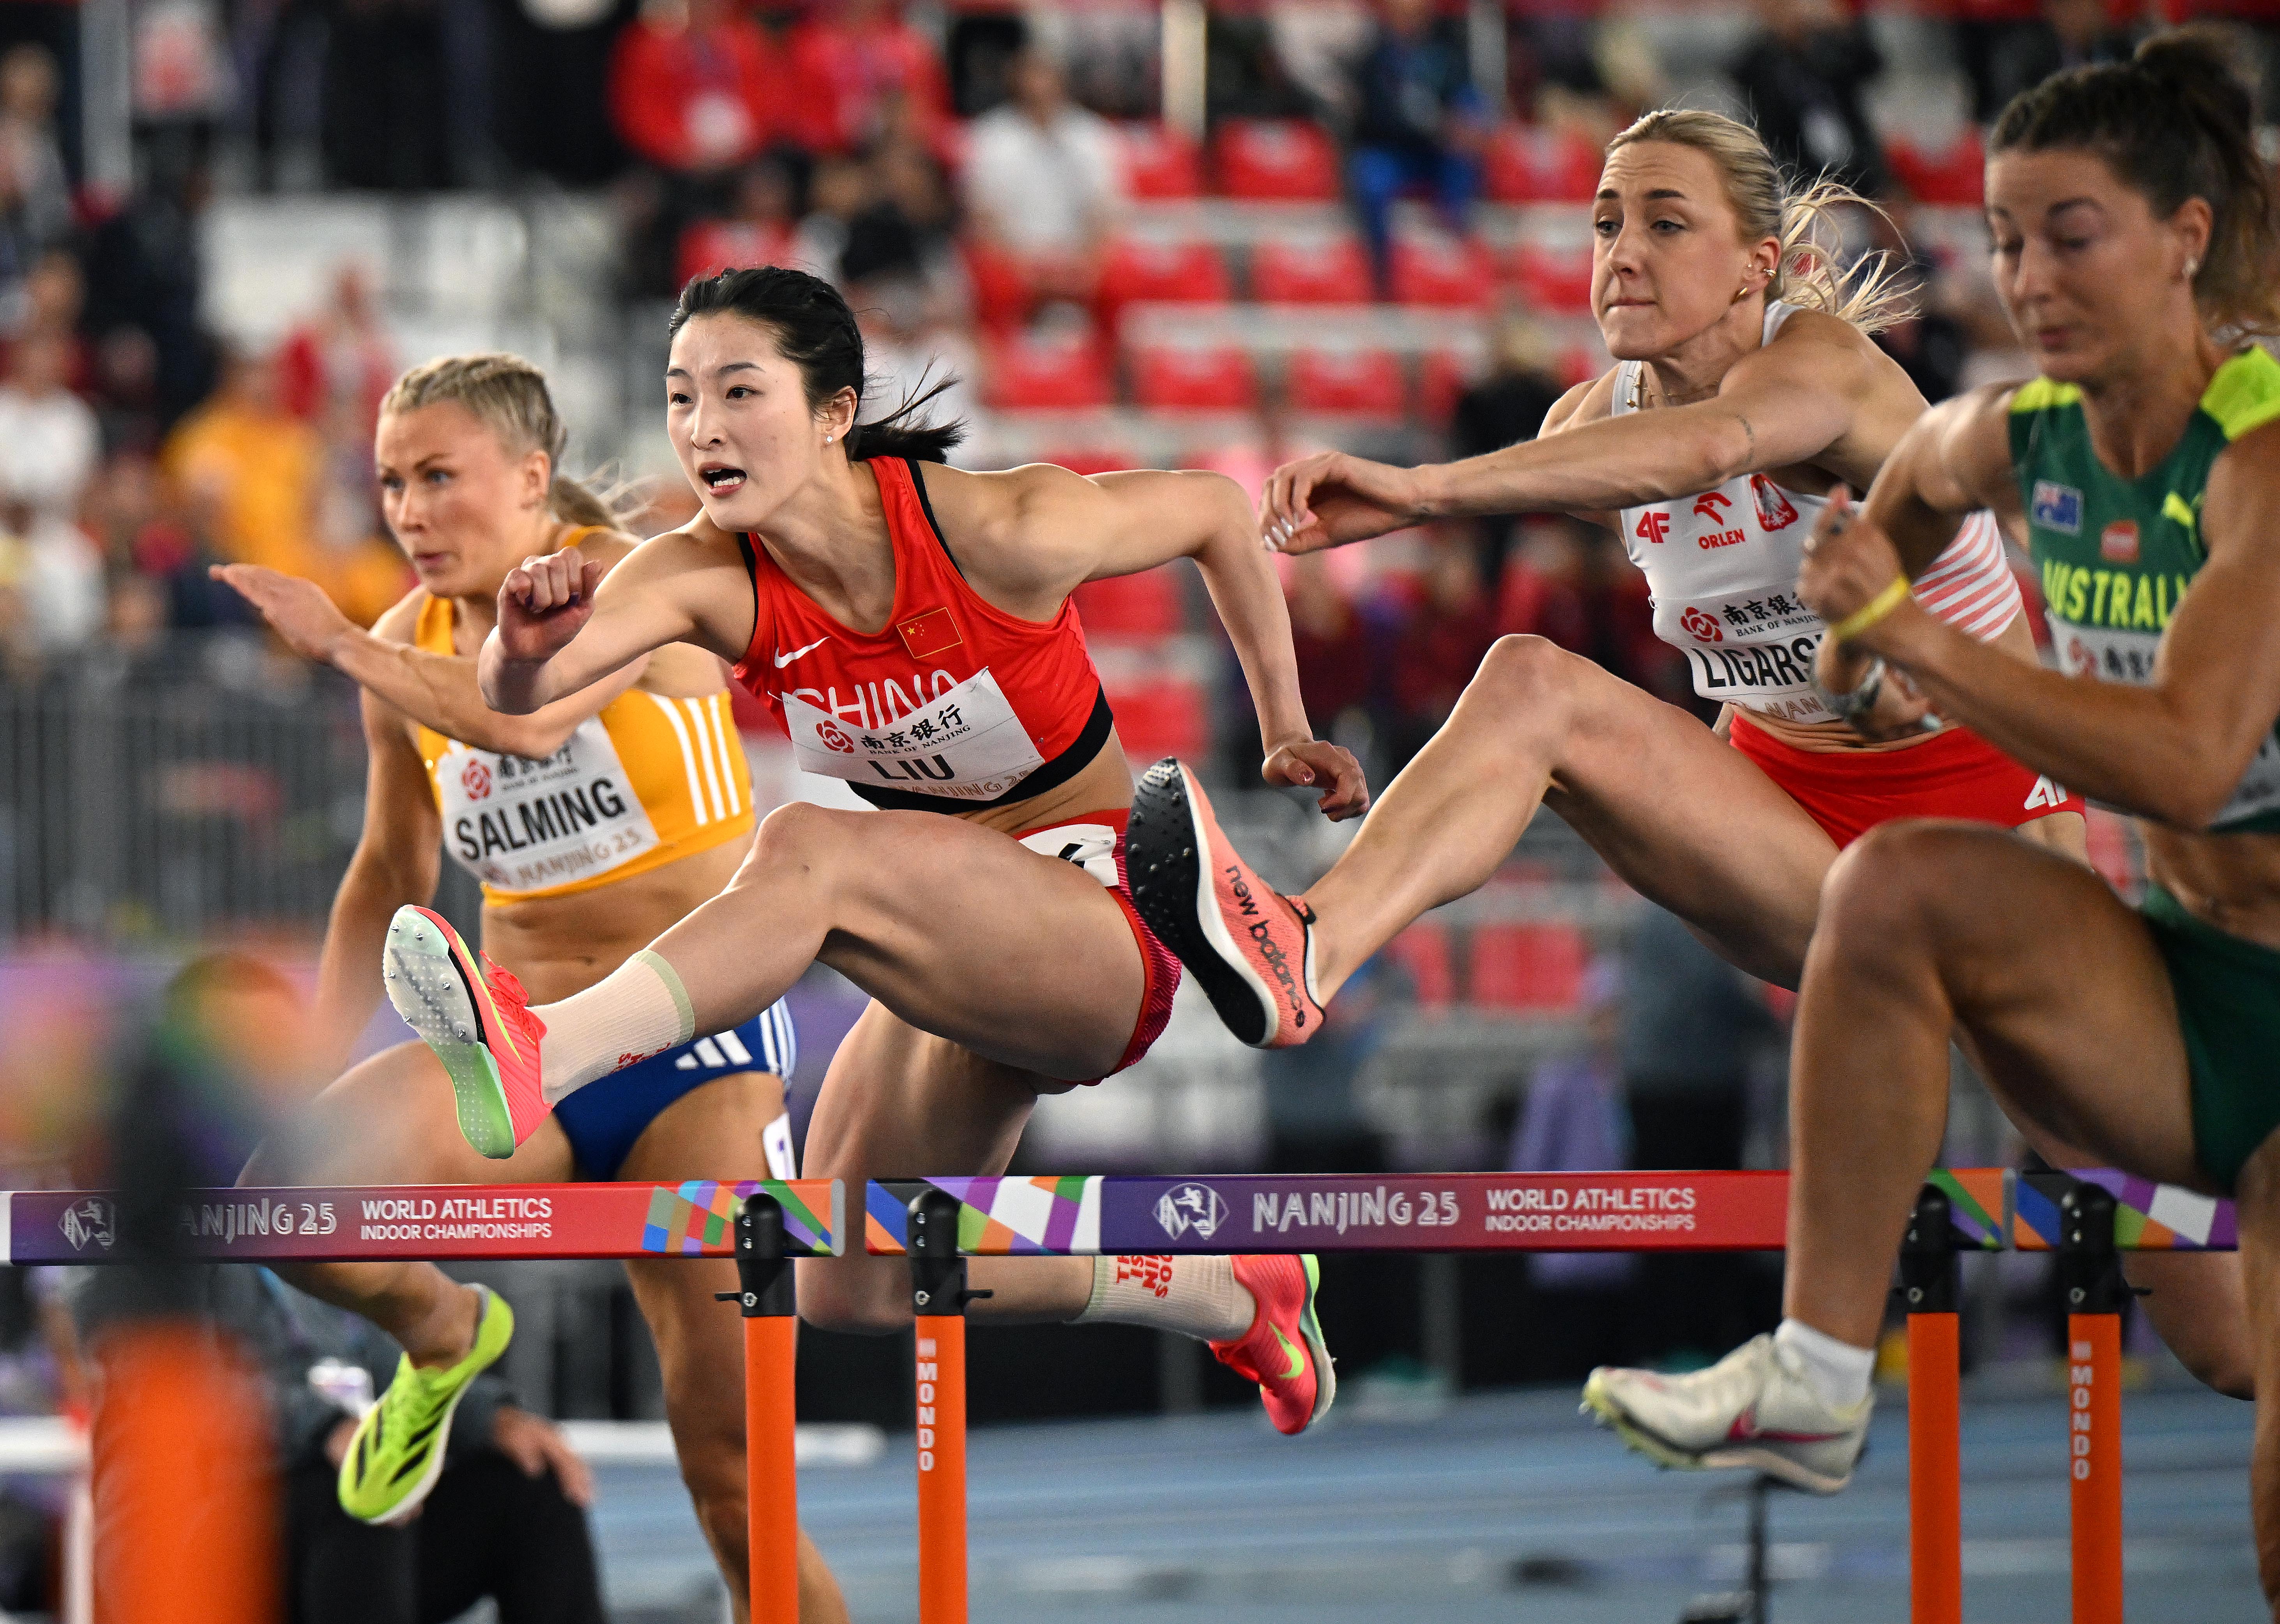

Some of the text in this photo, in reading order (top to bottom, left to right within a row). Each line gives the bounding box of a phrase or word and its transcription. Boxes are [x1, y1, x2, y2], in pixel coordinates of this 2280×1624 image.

[1636, 511, 1670, 544] 4F
[1698, 528, 1746, 549] ORLEN
[1723, 592, 1806, 625] 南京银
[1736, 624, 1765, 637] BANK
[1767, 620, 1780, 630] OF
[1691, 634, 1822, 688] LIGARS
[860, 704, 963, 749] 南京银行
[922, 724, 971, 748] NANJING
[868, 754, 955, 780] LIU
[455, 778, 626, 861] SALMING
[1226, 865, 1305, 1029] new balance
[361, 1198, 552, 1220] WORLD ATHLETICS
[1253, 1186, 1460, 1236] NANJING 25
[1486, 1187, 1696, 1211] WORLD ATHLETICS
[299, 1202, 338, 1235] 25
[361, 1222, 552, 1241] INDOOR CHAMPIONSHIPS
[1485, 1214, 1696, 1232] INDOOR CHAMPIONSHIPS
[917, 1363, 938, 1471] MONDO
[2071, 1365, 2093, 1480] MONDO
